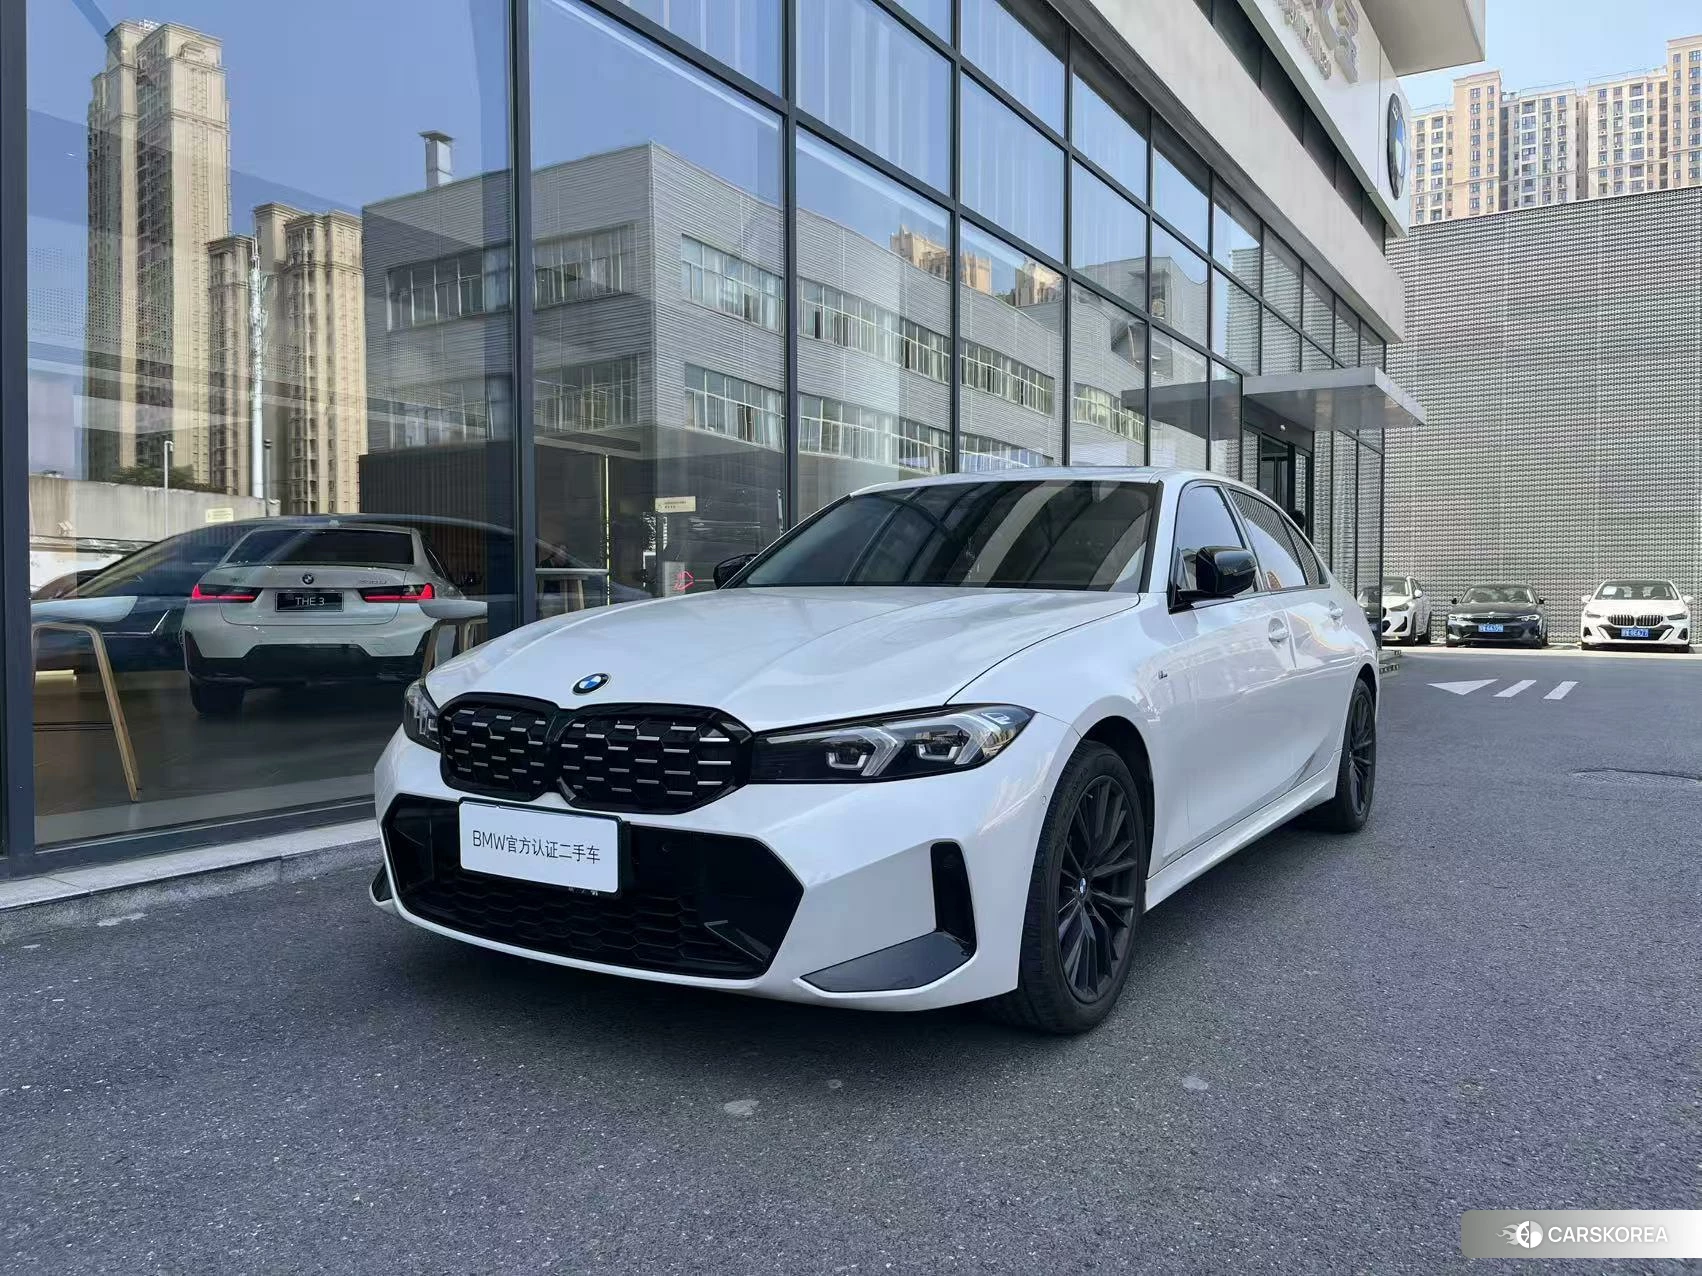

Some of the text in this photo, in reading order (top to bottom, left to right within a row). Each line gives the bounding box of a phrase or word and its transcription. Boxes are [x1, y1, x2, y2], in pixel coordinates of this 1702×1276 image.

[295, 597, 325, 606] THE 3
[472, 830, 601, 864] BMW官方认证二手车
